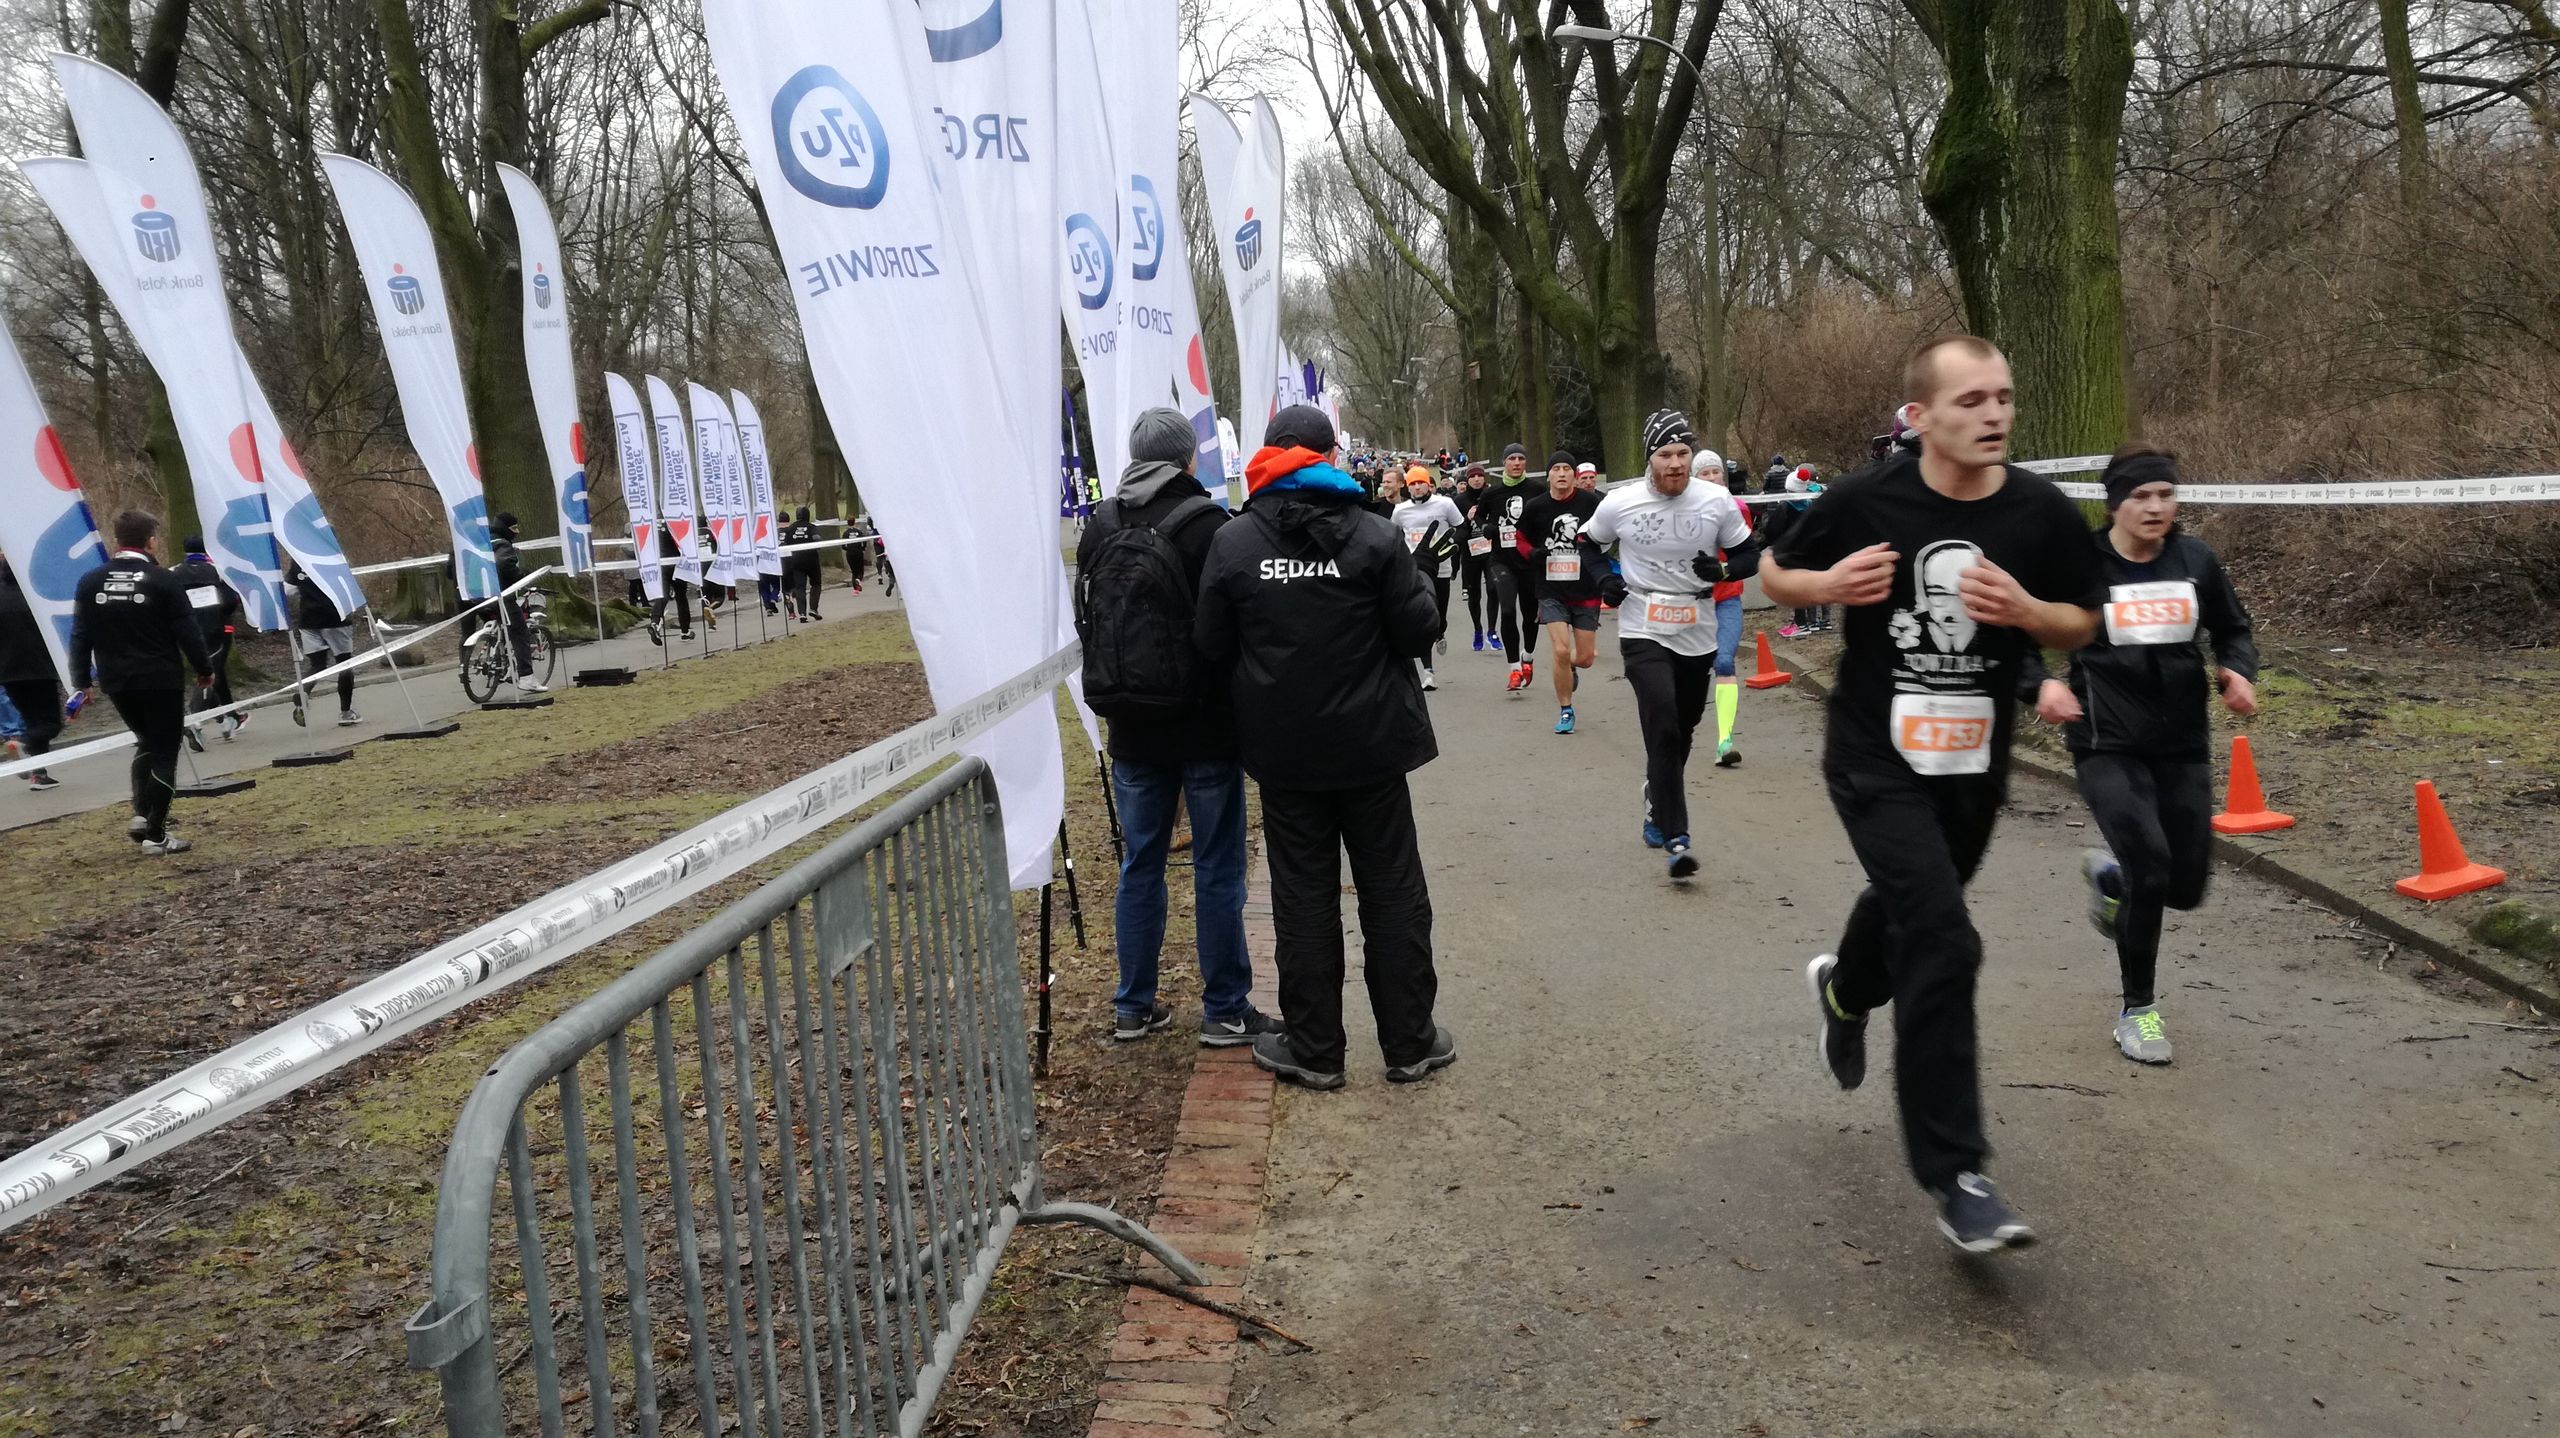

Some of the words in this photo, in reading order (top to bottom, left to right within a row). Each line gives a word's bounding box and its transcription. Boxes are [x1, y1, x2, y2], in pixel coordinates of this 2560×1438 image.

[1259, 558, 1341, 584] SĘDZIA
[1653, 606, 1692, 622] 4090
[1912, 722, 1982, 750] 4753
[375, 972, 457, 1020] TROPEMWILCZYM
[244, 1046, 286, 1069] INSTYTUT
